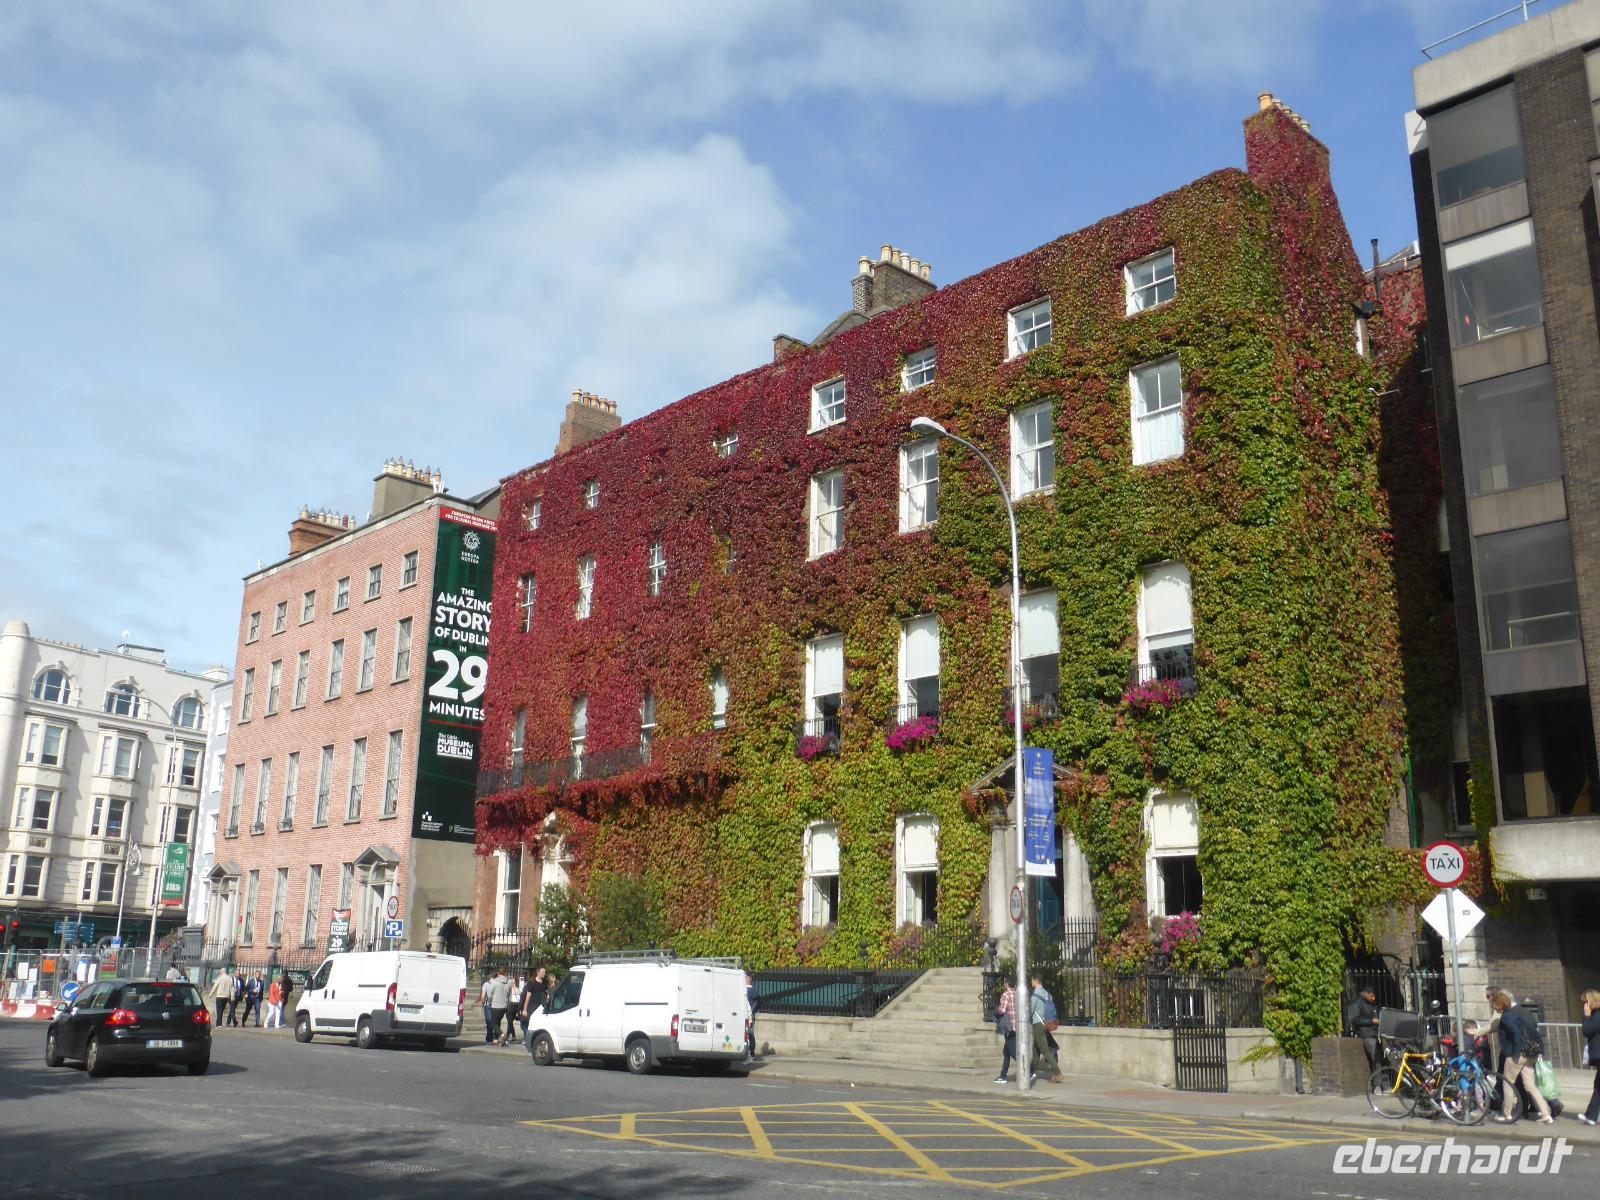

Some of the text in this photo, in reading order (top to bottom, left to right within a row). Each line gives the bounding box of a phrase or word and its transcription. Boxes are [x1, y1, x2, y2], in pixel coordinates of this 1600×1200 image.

[461, 587, 474, 596] THE
[437, 591, 493, 613] AMAZING
[435, 605, 492, 633] STORY
[434, 626, 451, 638] OF
[459, 645, 467, 653] IN
[429, 649, 489, 703] 29
[429, 700, 486, 721] MINUTES
[437, 737, 469, 748] MUSEUM
[437, 744, 473, 757] DUBLIN
[1429, 857, 1460, 869] TAXI
[389, 922, 399, 935] P
[331, 938, 343, 948] 29
